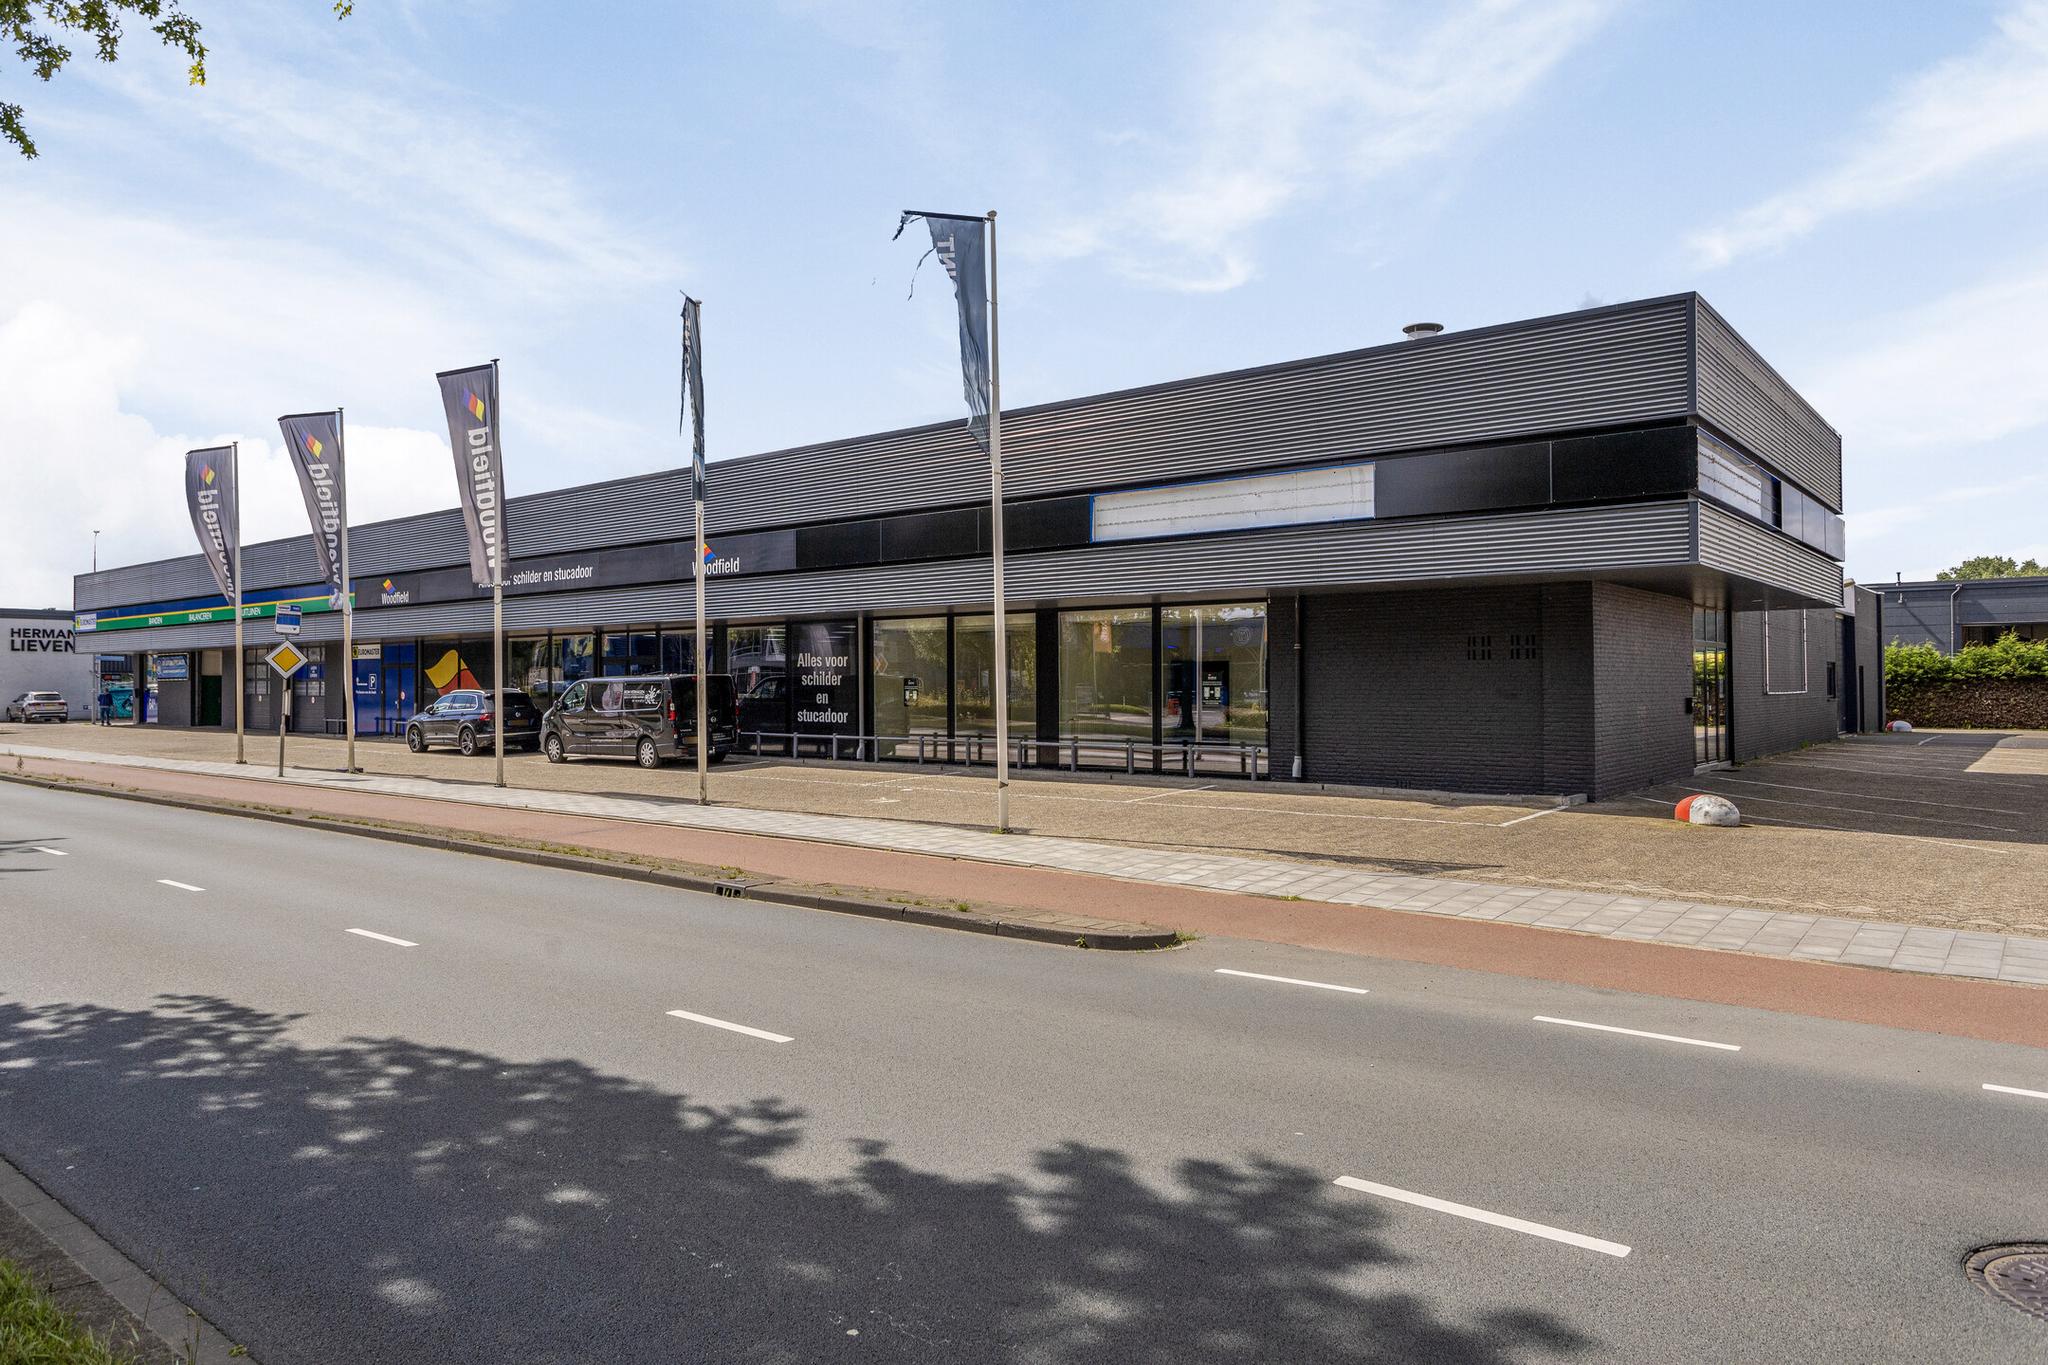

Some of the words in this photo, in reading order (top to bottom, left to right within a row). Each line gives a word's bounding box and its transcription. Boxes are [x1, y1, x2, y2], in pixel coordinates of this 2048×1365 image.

[513, 570, 542, 585] schilder
[543, 571, 553, 581] en
[554, 565, 593, 581] stucadoor
[381, 591, 409, 605] Woodfield
[10, 639, 75, 652] LIEVEN
[797, 653, 822, 667] Alles
[825, 656, 848, 667] voor
[801, 671, 842, 685] schilder
[816, 692, 828, 704] en
[797, 708, 848, 723] stucadoor
